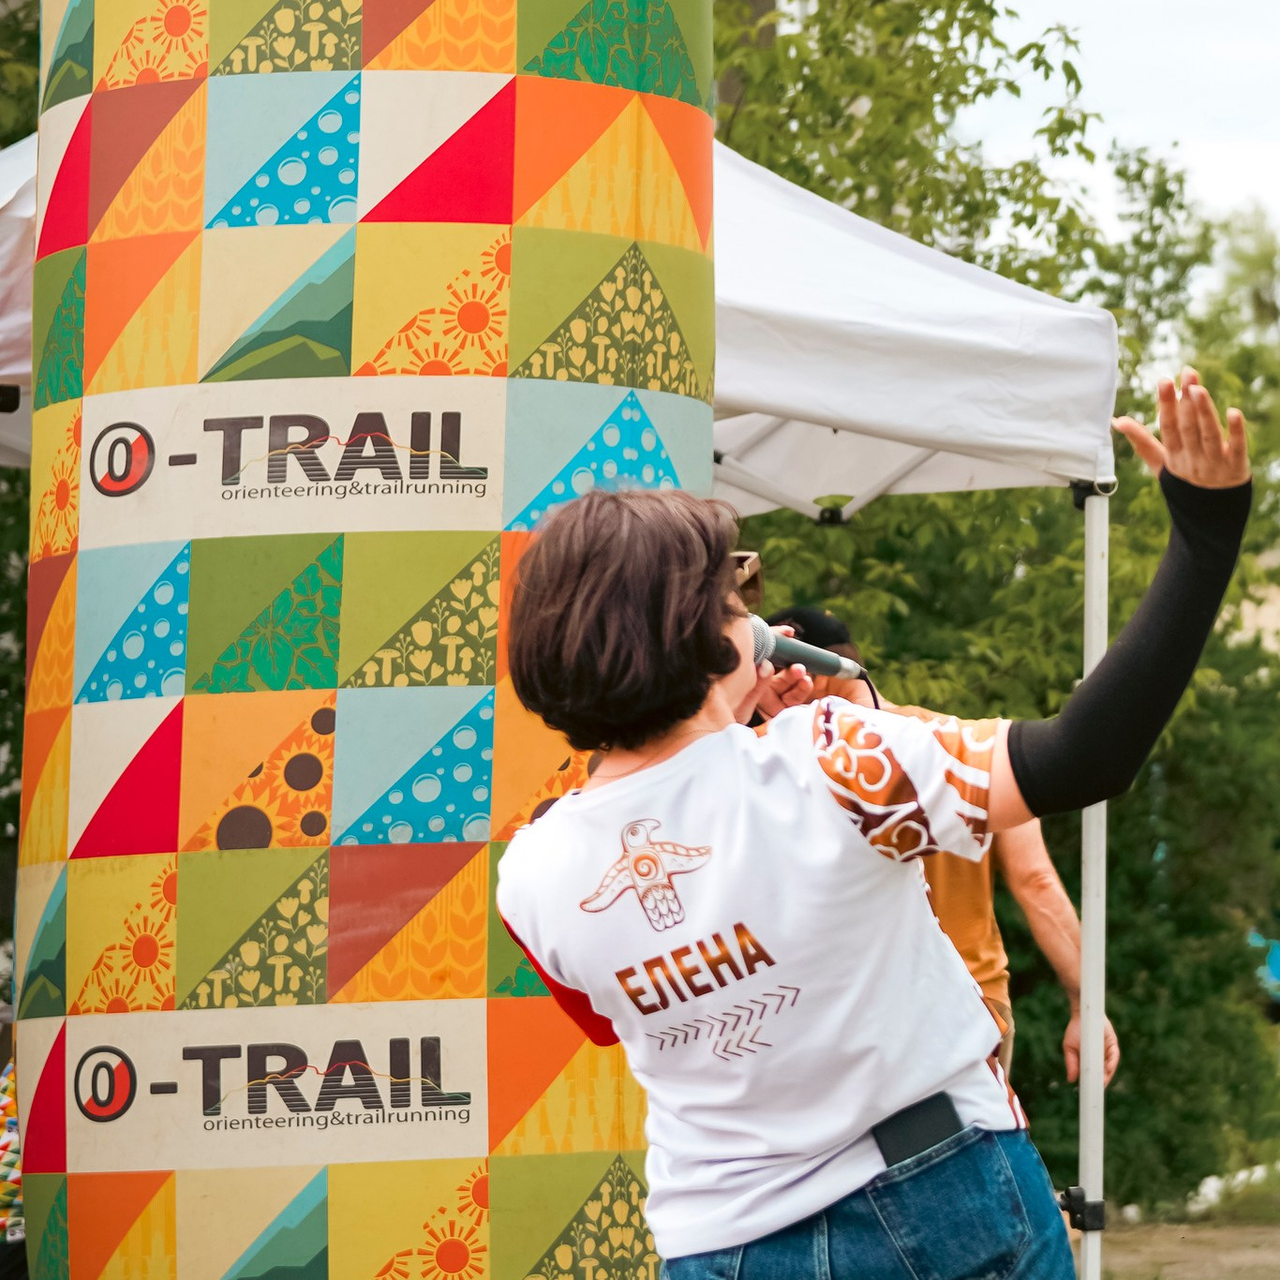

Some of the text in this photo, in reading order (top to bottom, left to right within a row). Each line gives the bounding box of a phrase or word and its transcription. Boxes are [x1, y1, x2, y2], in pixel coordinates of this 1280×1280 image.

[221, 479, 487, 501] orienteering&trailrunning
[614, 922, 776, 1015] ЕЛЕНА
[203, 1106, 470, 1129] orienteering&trailrunning
